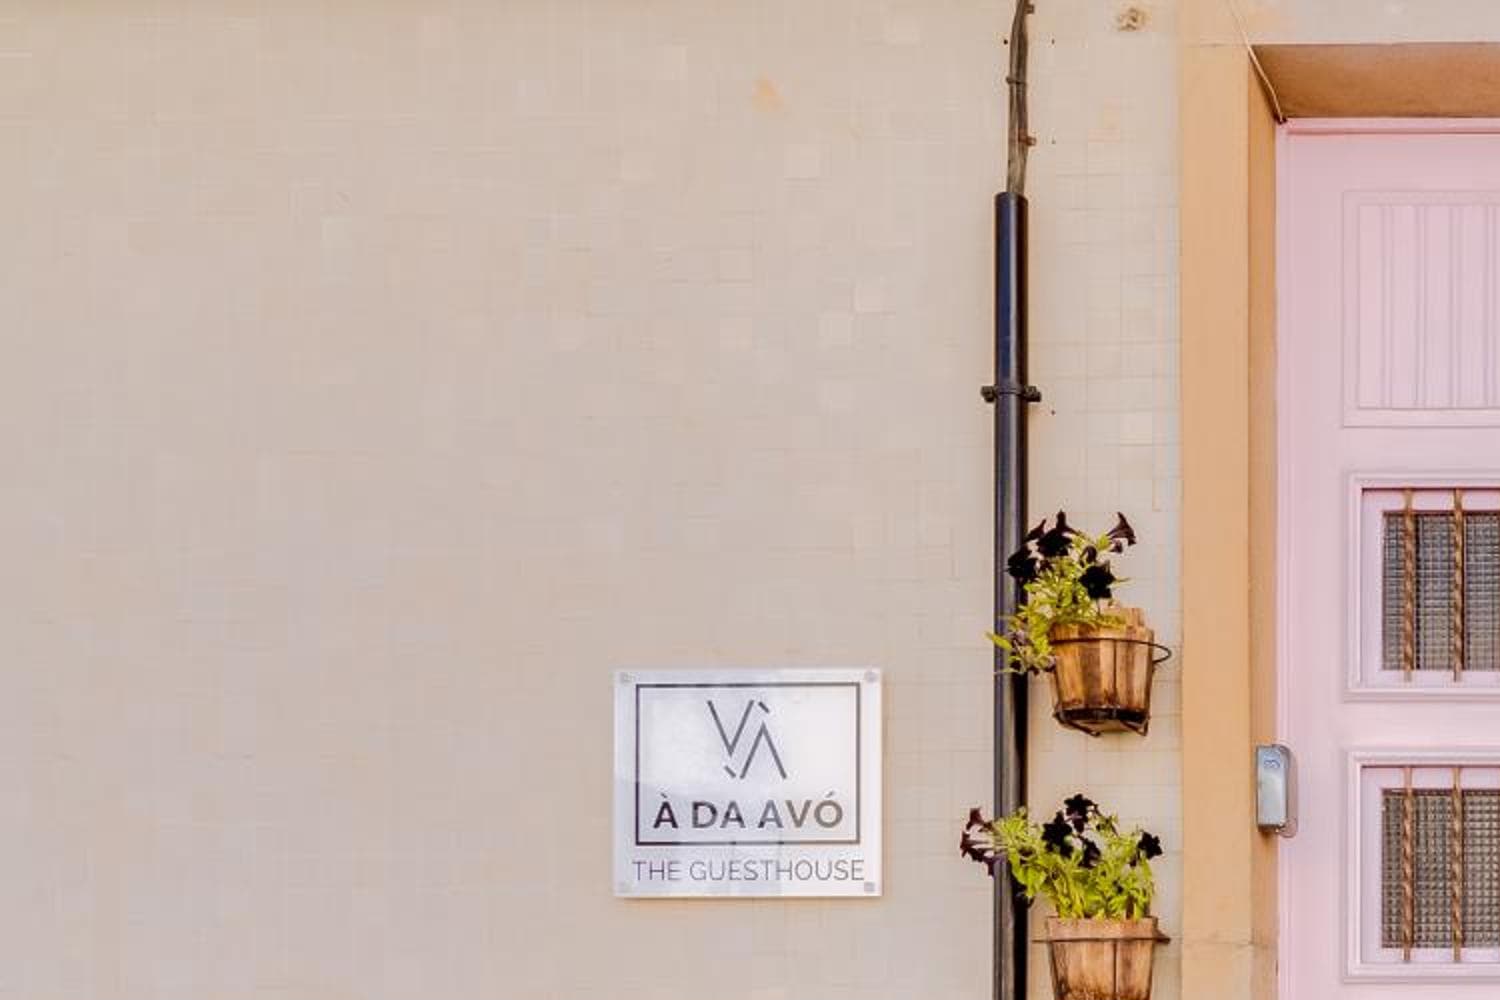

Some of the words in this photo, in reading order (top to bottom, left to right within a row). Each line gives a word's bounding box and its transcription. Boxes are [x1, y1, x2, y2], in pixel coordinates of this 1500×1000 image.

[653, 792, 679, 829] À
[691, 801, 746, 829] DA
[758, 791, 844, 829] AVÓ
[633, 861, 683, 881] THE
[689, 859, 865, 881] GUESTHOUSE
